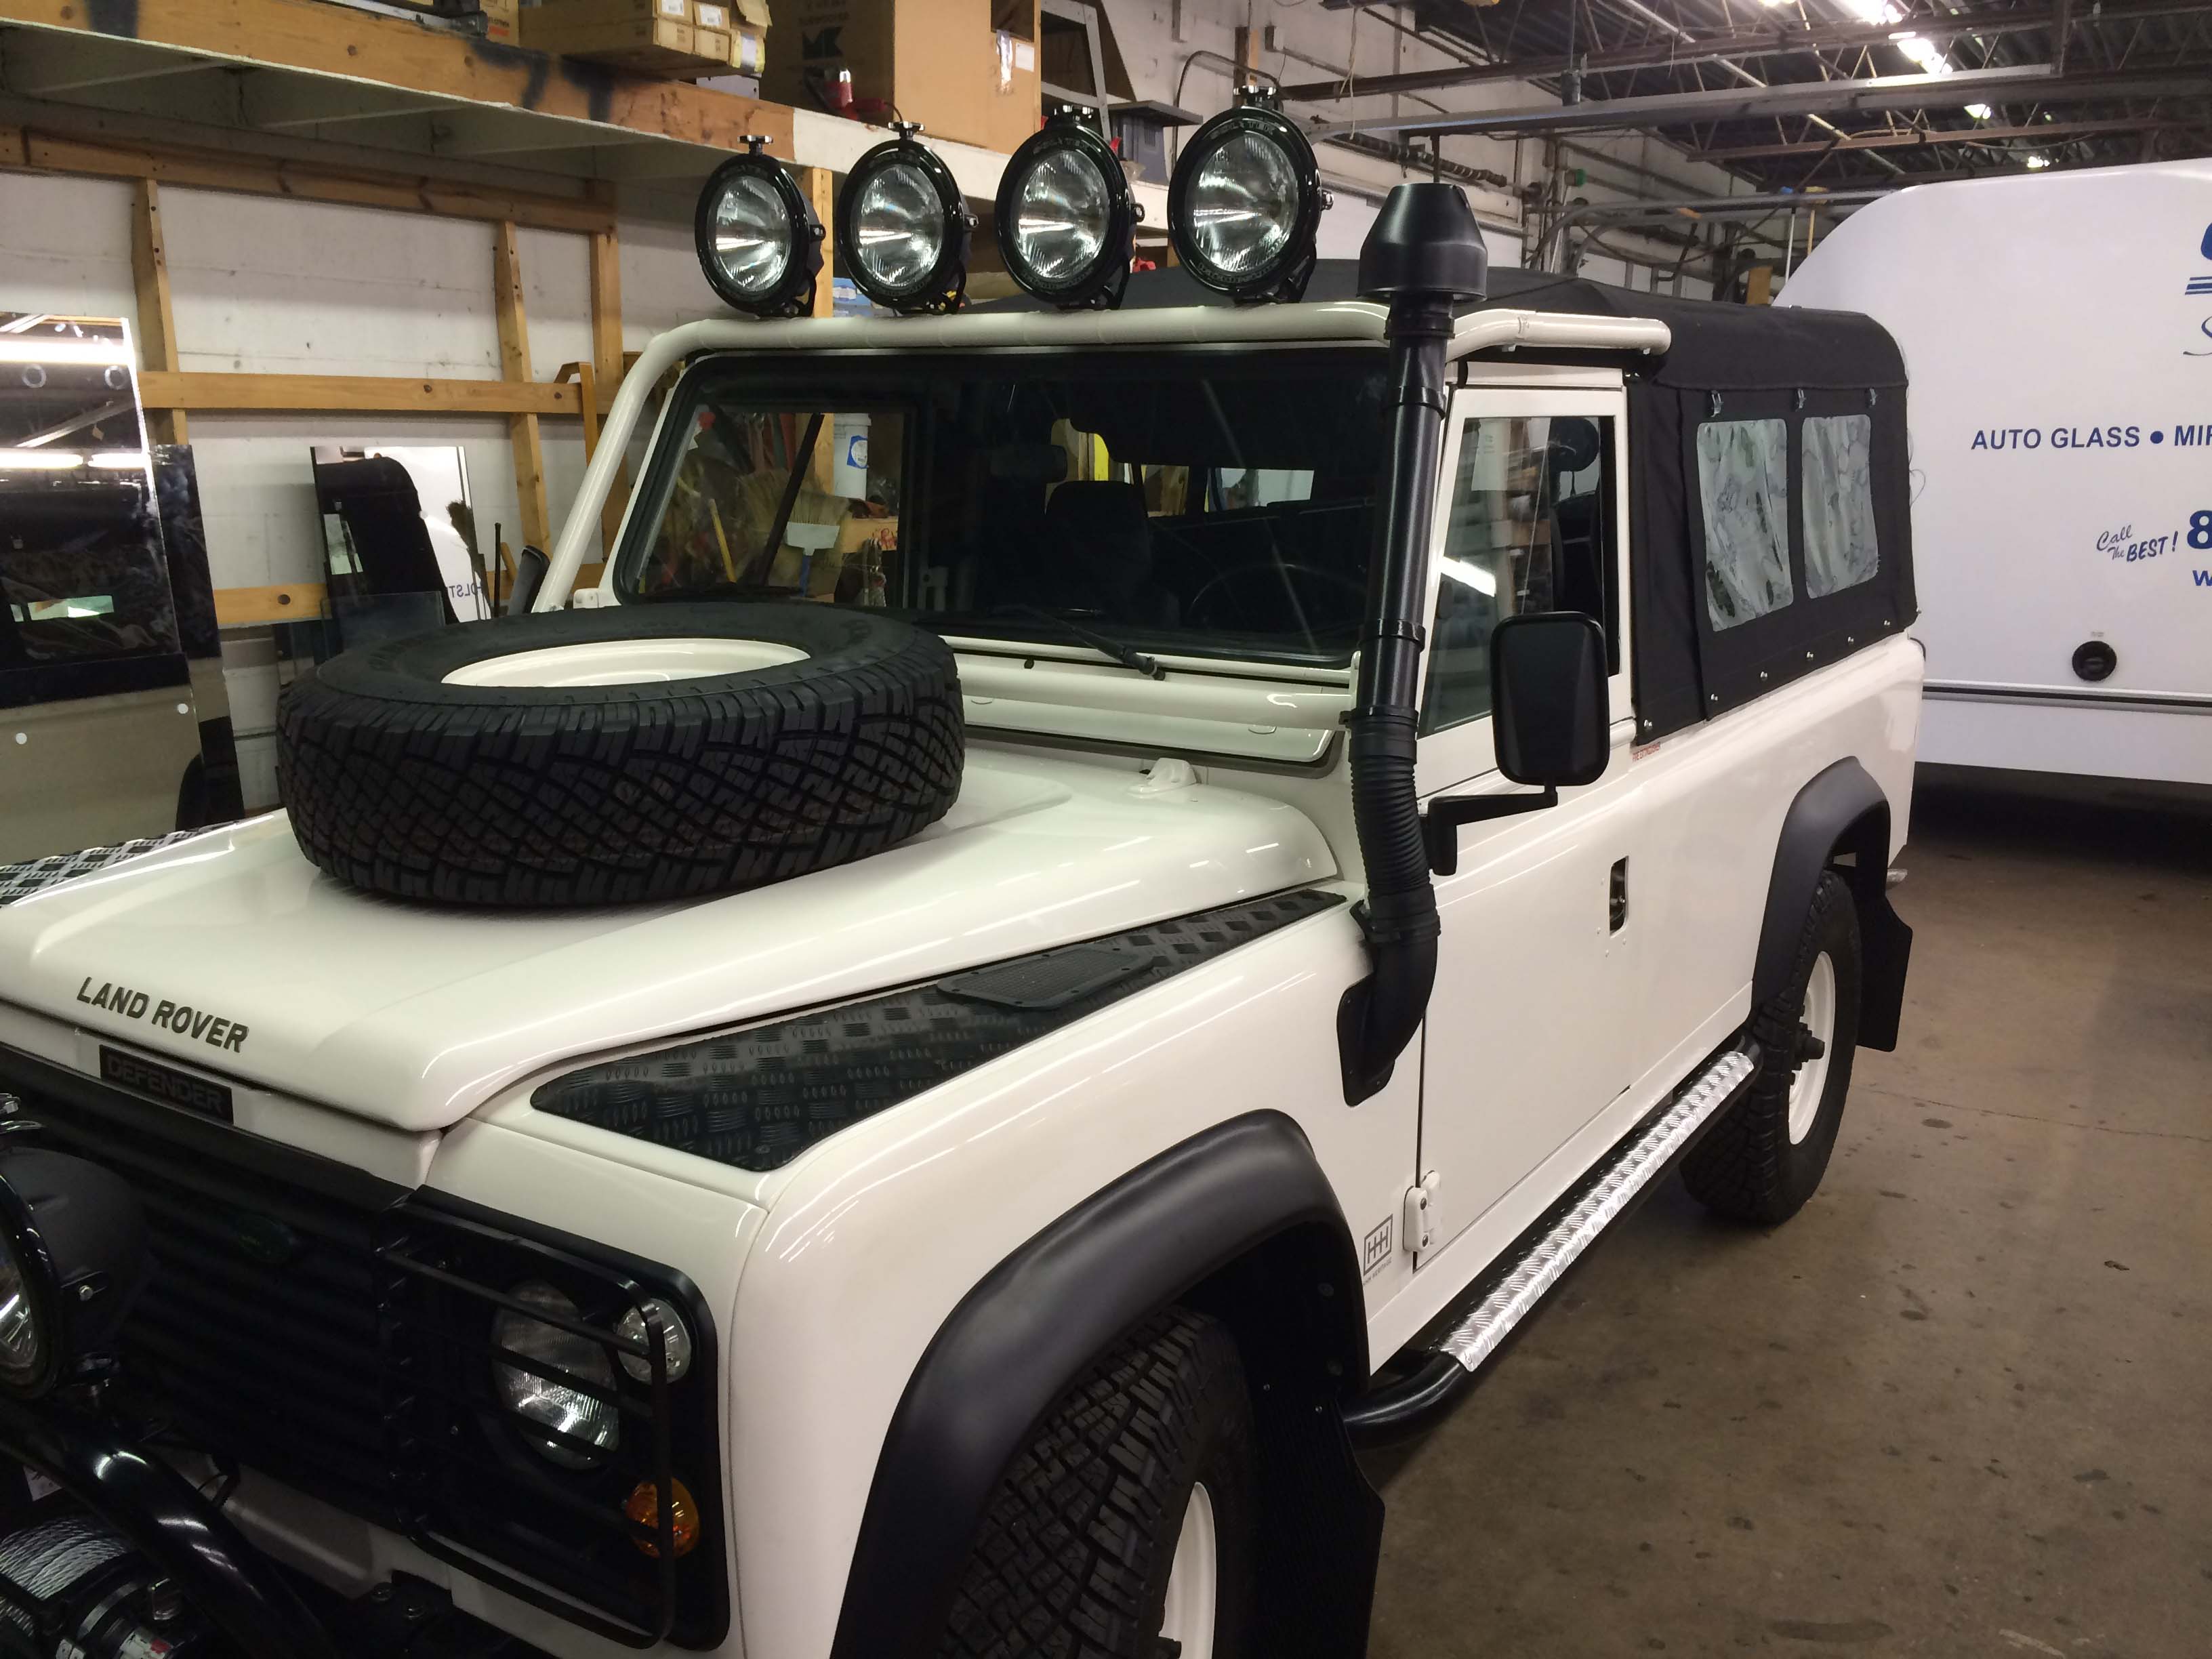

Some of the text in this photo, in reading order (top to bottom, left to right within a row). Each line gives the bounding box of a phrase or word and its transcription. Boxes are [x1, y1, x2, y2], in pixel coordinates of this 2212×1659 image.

[1970, 428, 2042, 450] AUTO
[2051, 426, 2140, 448] GLASS
[2096, 525, 2133, 552] Call
[2107, 545, 2125, 560] The
[76, 976, 250, 1053] LAND ROVER
[107, 1054, 224, 1116] DEFENDER
